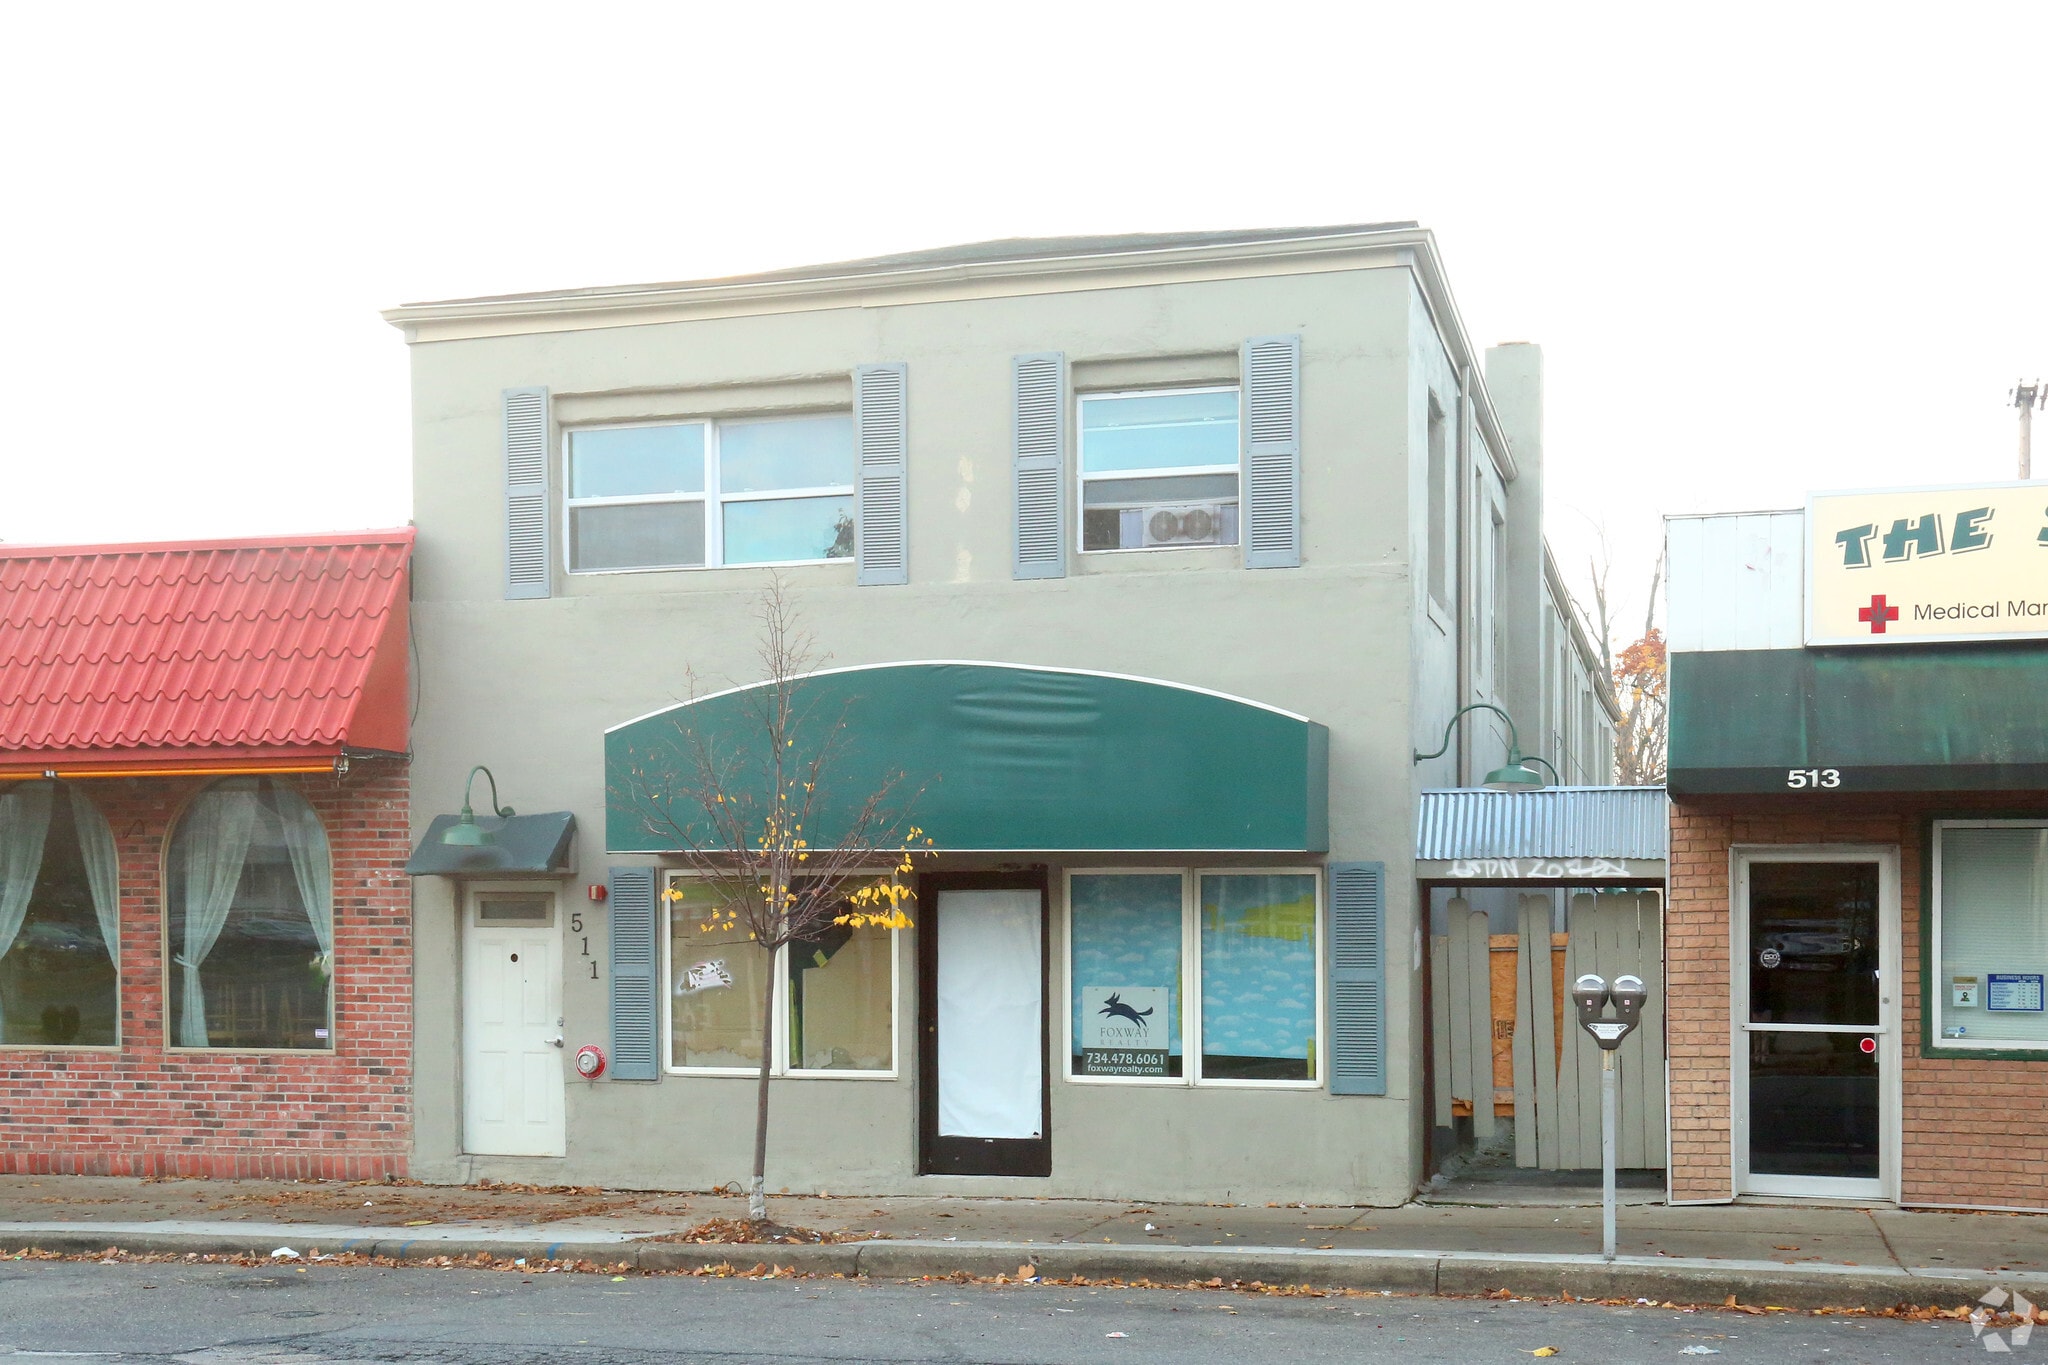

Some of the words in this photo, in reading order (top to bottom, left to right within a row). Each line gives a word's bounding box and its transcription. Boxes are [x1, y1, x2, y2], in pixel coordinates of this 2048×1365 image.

[1835, 506, 1995, 569] THE
[1914, 602, 1999, 620] Medical
[1787, 769, 1841, 789] 513
[1100, 1027, 1150, 1038] FOXWAY
[1100, 1039, 1150, 1047] REALTY
[1087, 1052, 1165, 1065] 734.478.6061
[1087, 1064, 1163, 1075] foxwayrealty.com
